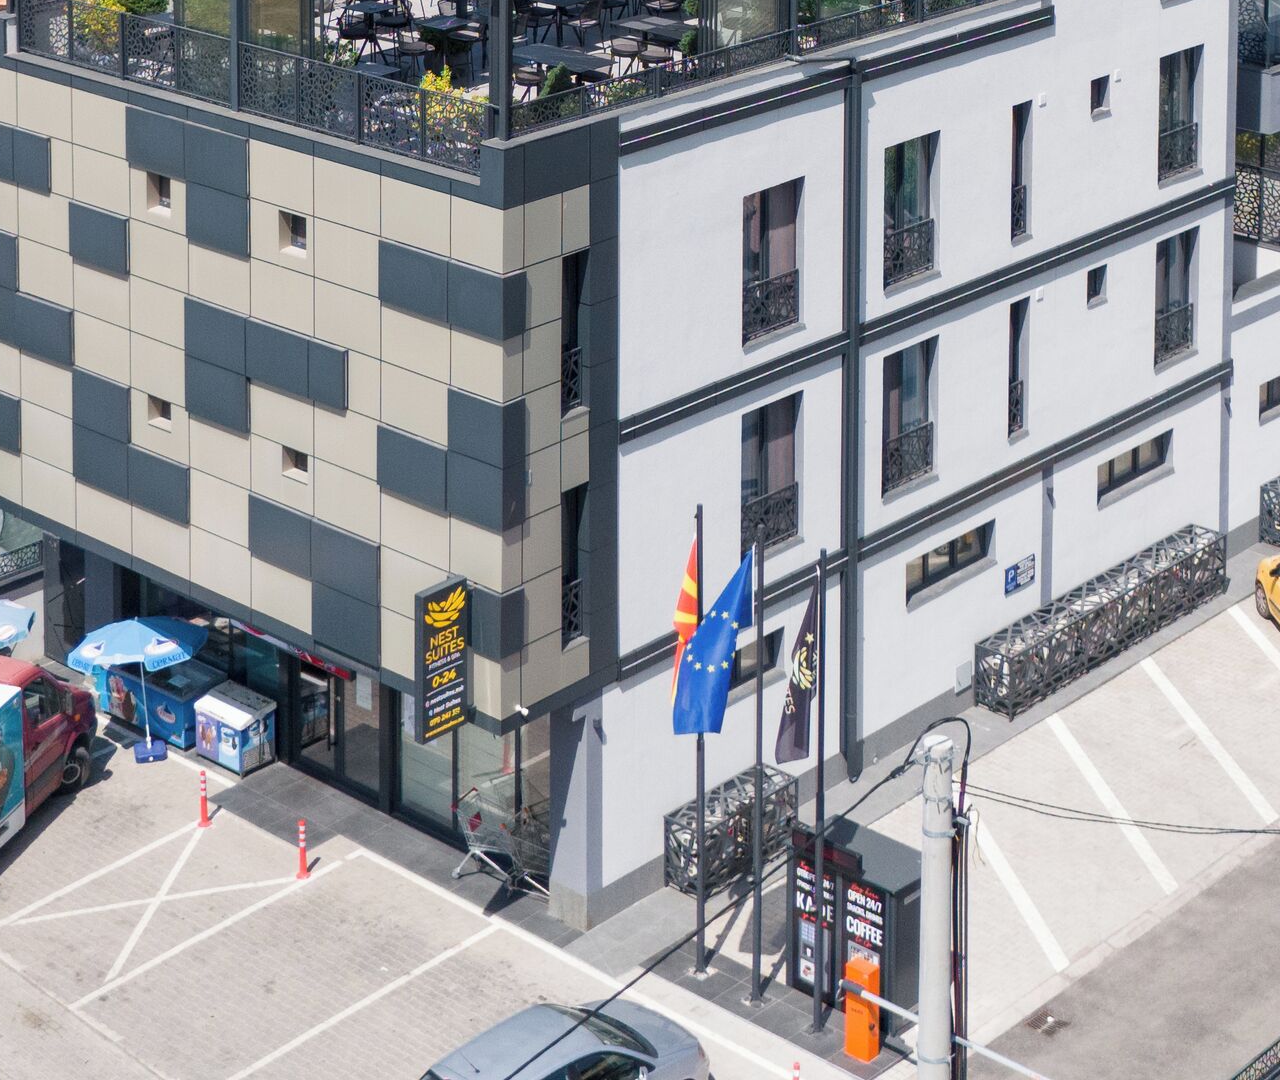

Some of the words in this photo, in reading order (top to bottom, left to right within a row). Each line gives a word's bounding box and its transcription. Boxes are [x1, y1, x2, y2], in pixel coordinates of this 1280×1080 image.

[1008, 569, 1015, 582] P
[430, 625, 460, 648] NEST
[425, 637, 465, 665] SUITES
[432, 667, 457, 688] 0-24
[847, 889, 865, 906] OPEN
[865, 897, 882, 914] 24/7
[846, 915, 883, 947] COFFEE
